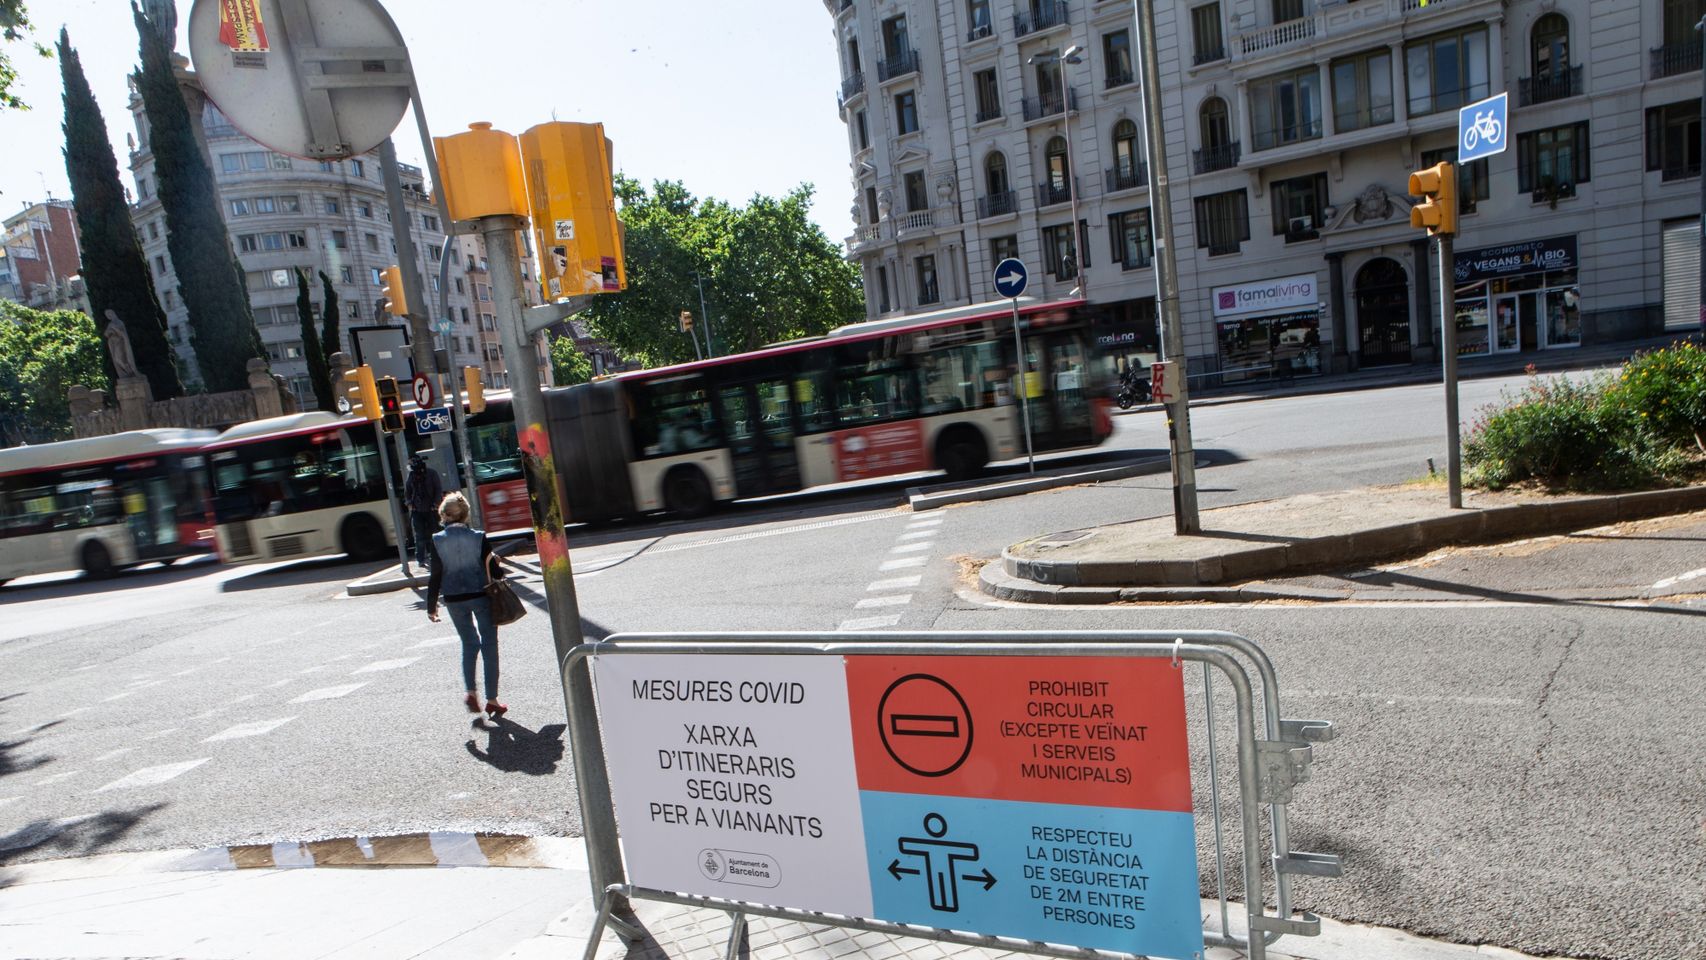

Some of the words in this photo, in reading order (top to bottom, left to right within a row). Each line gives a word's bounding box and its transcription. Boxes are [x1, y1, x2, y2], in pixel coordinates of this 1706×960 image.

[1473, 255, 1520, 270] VEGANS
[1523, 254, 1531, 263] &
[1544, 249, 1566, 260] BIO
[1238, 283, 1310, 302] famaliving
[633, 680, 732, 702] MESURES
[740, 682, 804, 704] COVID
[1029, 681, 1108, 696] PROHIBIT
[1027, 702, 1113, 718] CIRCULAR
[684, 724, 757, 747] XARXA
[1000, 721, 1080, 738] (EXCEPTE
[1085, 720, 1147, 741] VEÏNAT
[1033, 744, 1037, 757] I
[1043, 744, 1115, 761] SERVEIS
[659, 750, 795, 778] D’ITINERARIS
[1022, 764, 1131, 784] MUNICIPALS)
[687, 779, 772, 805] SEGURS
[650, 803, 688, 824] PER
[696, 807, 708, 826] A
[712, 808, 822, 838] VIANANTS
[1032, 826, 1131, 846] RESPECTEU
[729, 858, 760, 868] Ajuntament
[1027, 846, 1047, 860] LA
[1052, 845, 1142, 869] DISTÀNCIA
[730, 866, 769, 878] Barcelona
[1024, 865, 1045, 880] DE
[1050, 868, 1148, 890] SEGURETAT
[1031, 885, 1052, 900] DE
[1058, 889, 1081, 903] 2M
[1088, 891, 1145, 910] ENTRE
[1044, 905, 1135, 929] PERSONES
